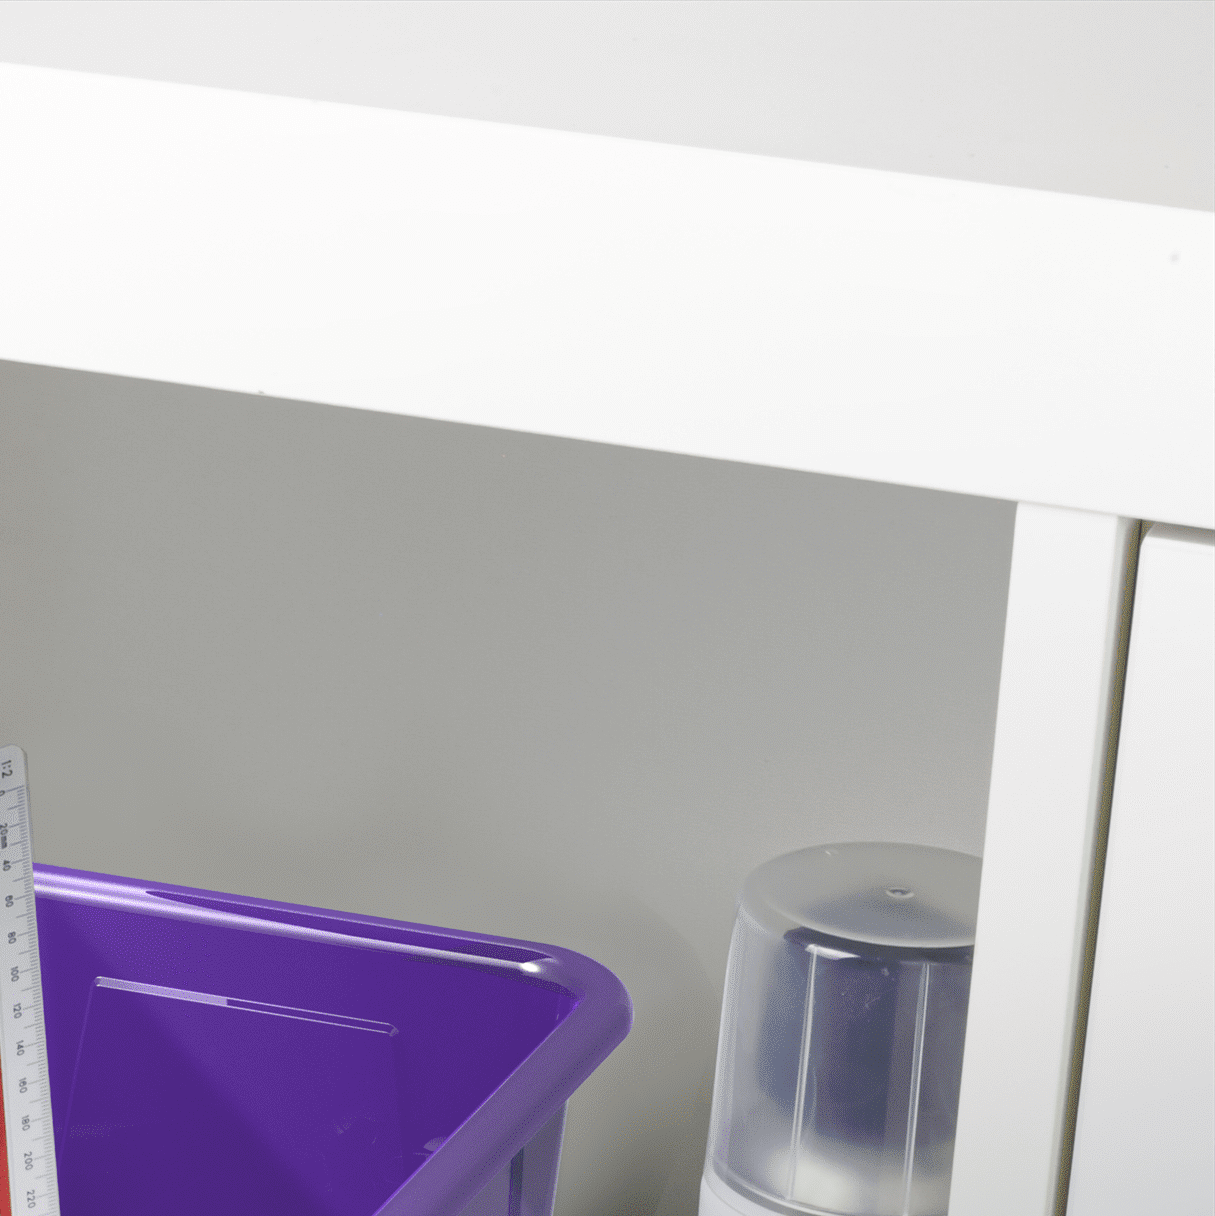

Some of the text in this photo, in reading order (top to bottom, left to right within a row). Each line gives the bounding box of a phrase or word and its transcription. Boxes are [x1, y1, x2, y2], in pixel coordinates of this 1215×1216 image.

[1, 759, 13, 779] 1:2
[0, 823, 9, 850] 20mm
[2, 859, 12, 872] 40
[10, 966, 20, 983] 100
[13, 1002, 23, 1019] 120
[16, 1040, 25, 1056] 140
[19, 1077, 28, 1094] 160
[21, 1114, 31, 1132] 180
[24, 1151, 33, 1171] 200
[26, 1189, 36, 1209] 220
